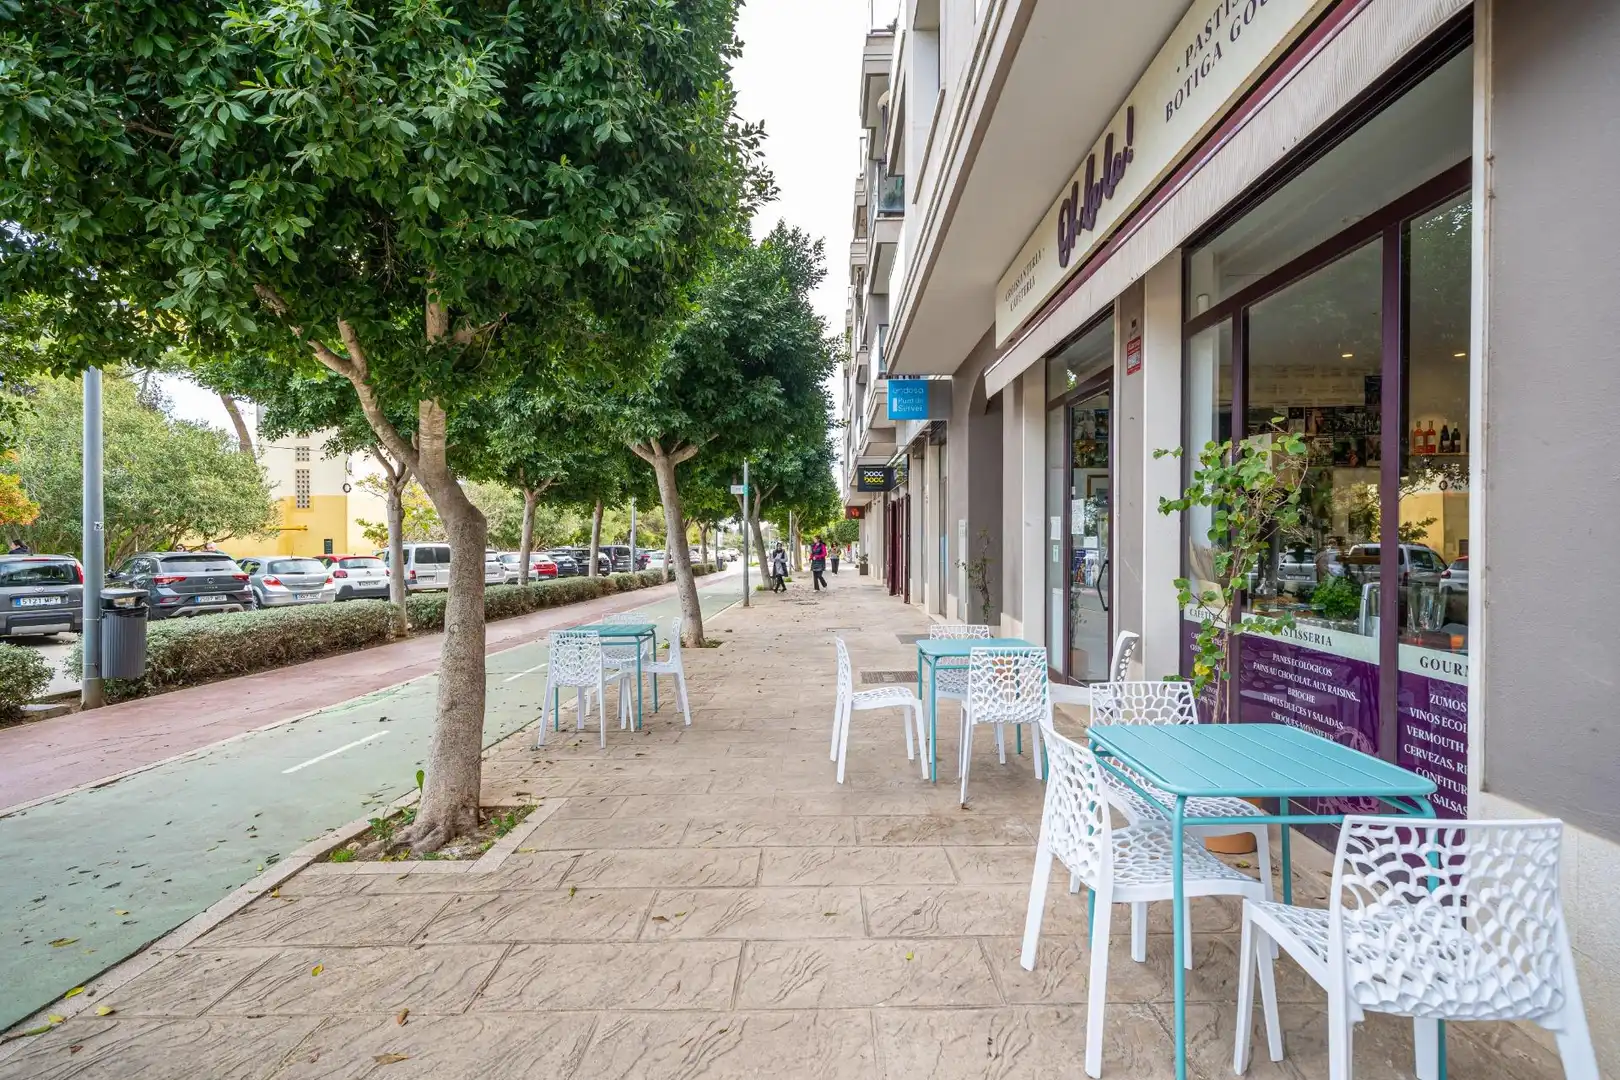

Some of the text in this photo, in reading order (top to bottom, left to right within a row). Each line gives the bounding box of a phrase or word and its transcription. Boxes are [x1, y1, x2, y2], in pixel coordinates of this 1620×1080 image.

[1166, 0, 1270, 123] BOTIGA GO
[1281, 627, 1333, 647] STISSERIA
[1273, 653, 1291, 666] PANES
[1253, 662, 1269, 673] PAINS
[1269, 667, 1278, 676] AU
[1313, 680, 1327, 693] AUX
[1287, 687, 1316, 704] BRIOCHE
[1429, 693, 1467, 713] ZUMOS
[1263, 693, 1284, 708] TARTAS
[1284, 700, 1307, 717] DULCES
[1313, 711, 1344, 730] SALADAS
[1409, 707, 1440, 726] VINOS
[1406, 724, 1464, 754] VERMOUTH
[1404, 743, 1455, 772] CERVEZAS,
